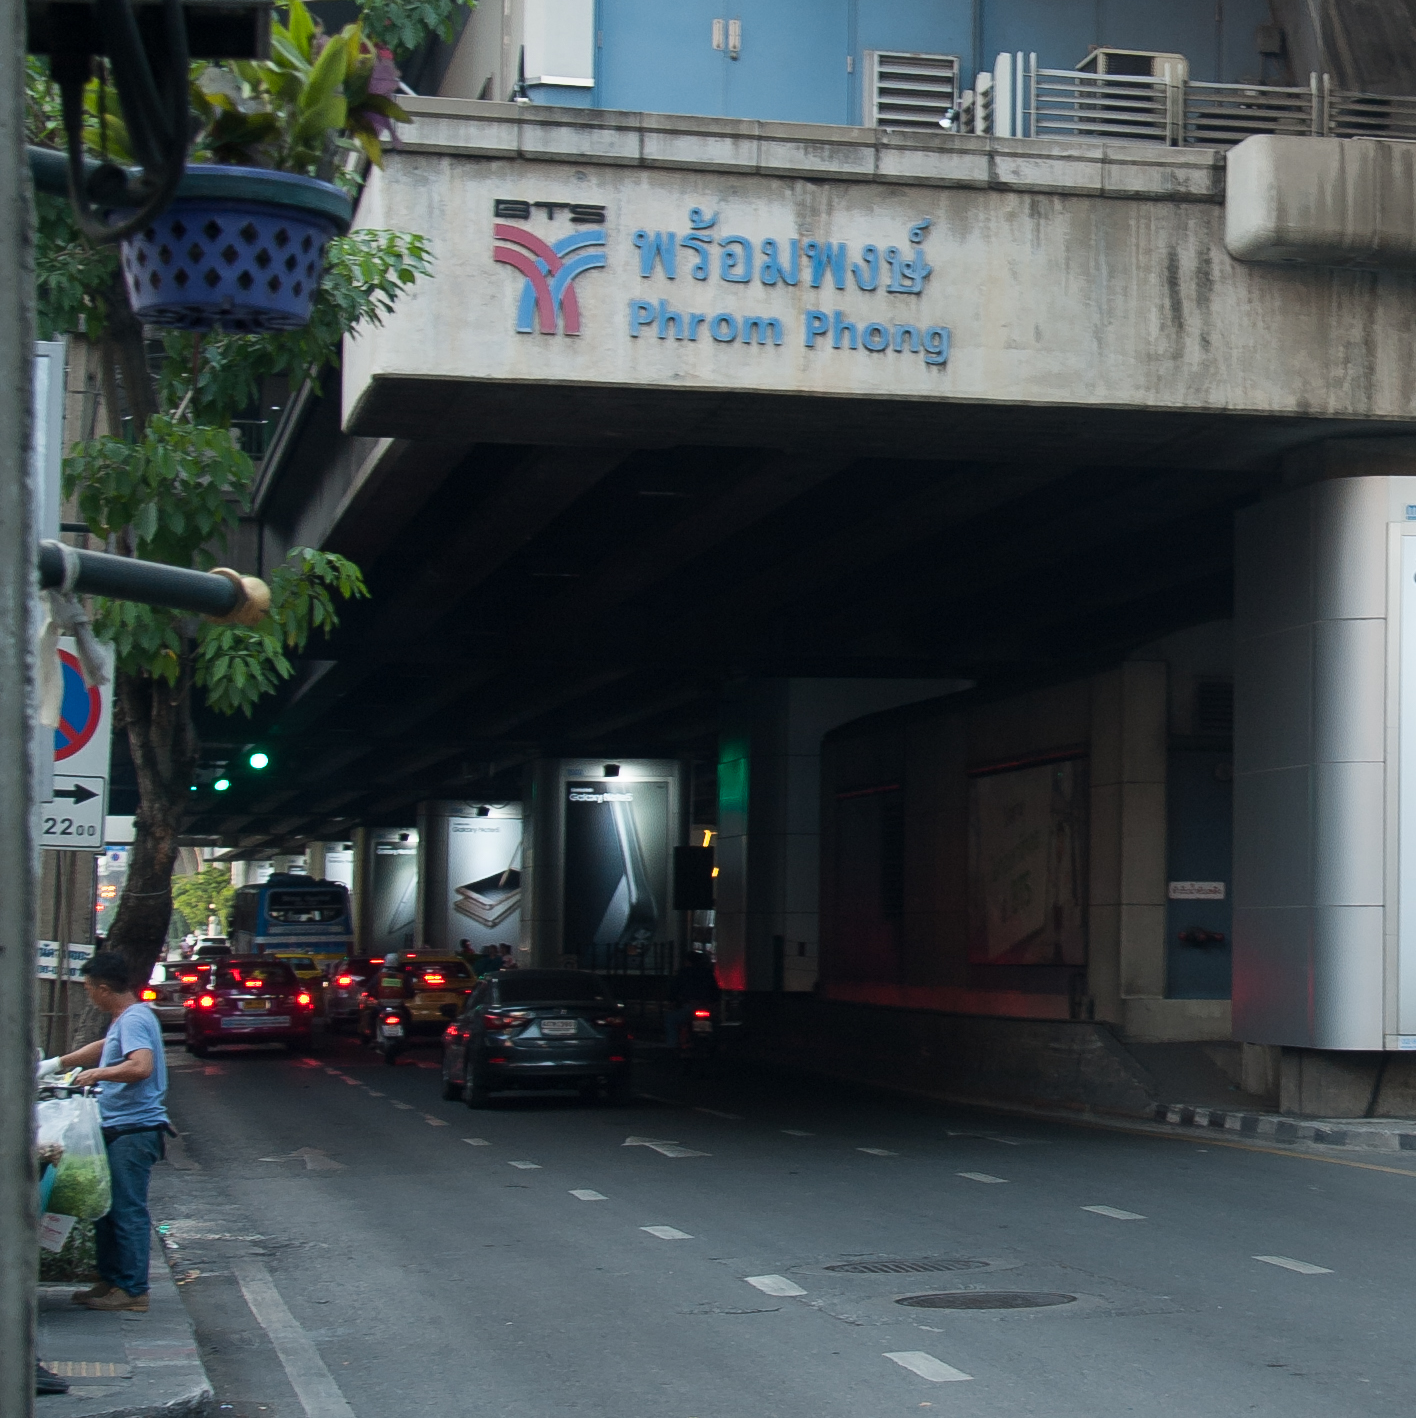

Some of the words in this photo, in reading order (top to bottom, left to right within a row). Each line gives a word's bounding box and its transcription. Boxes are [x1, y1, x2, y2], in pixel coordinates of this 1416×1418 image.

[493, 198, 607, 223] BTS
[632, 206, 933, 295] พร้อมพงษ์
[629, 298, 784, 347] Phrom
[803, 309, 951, 366] Phong
